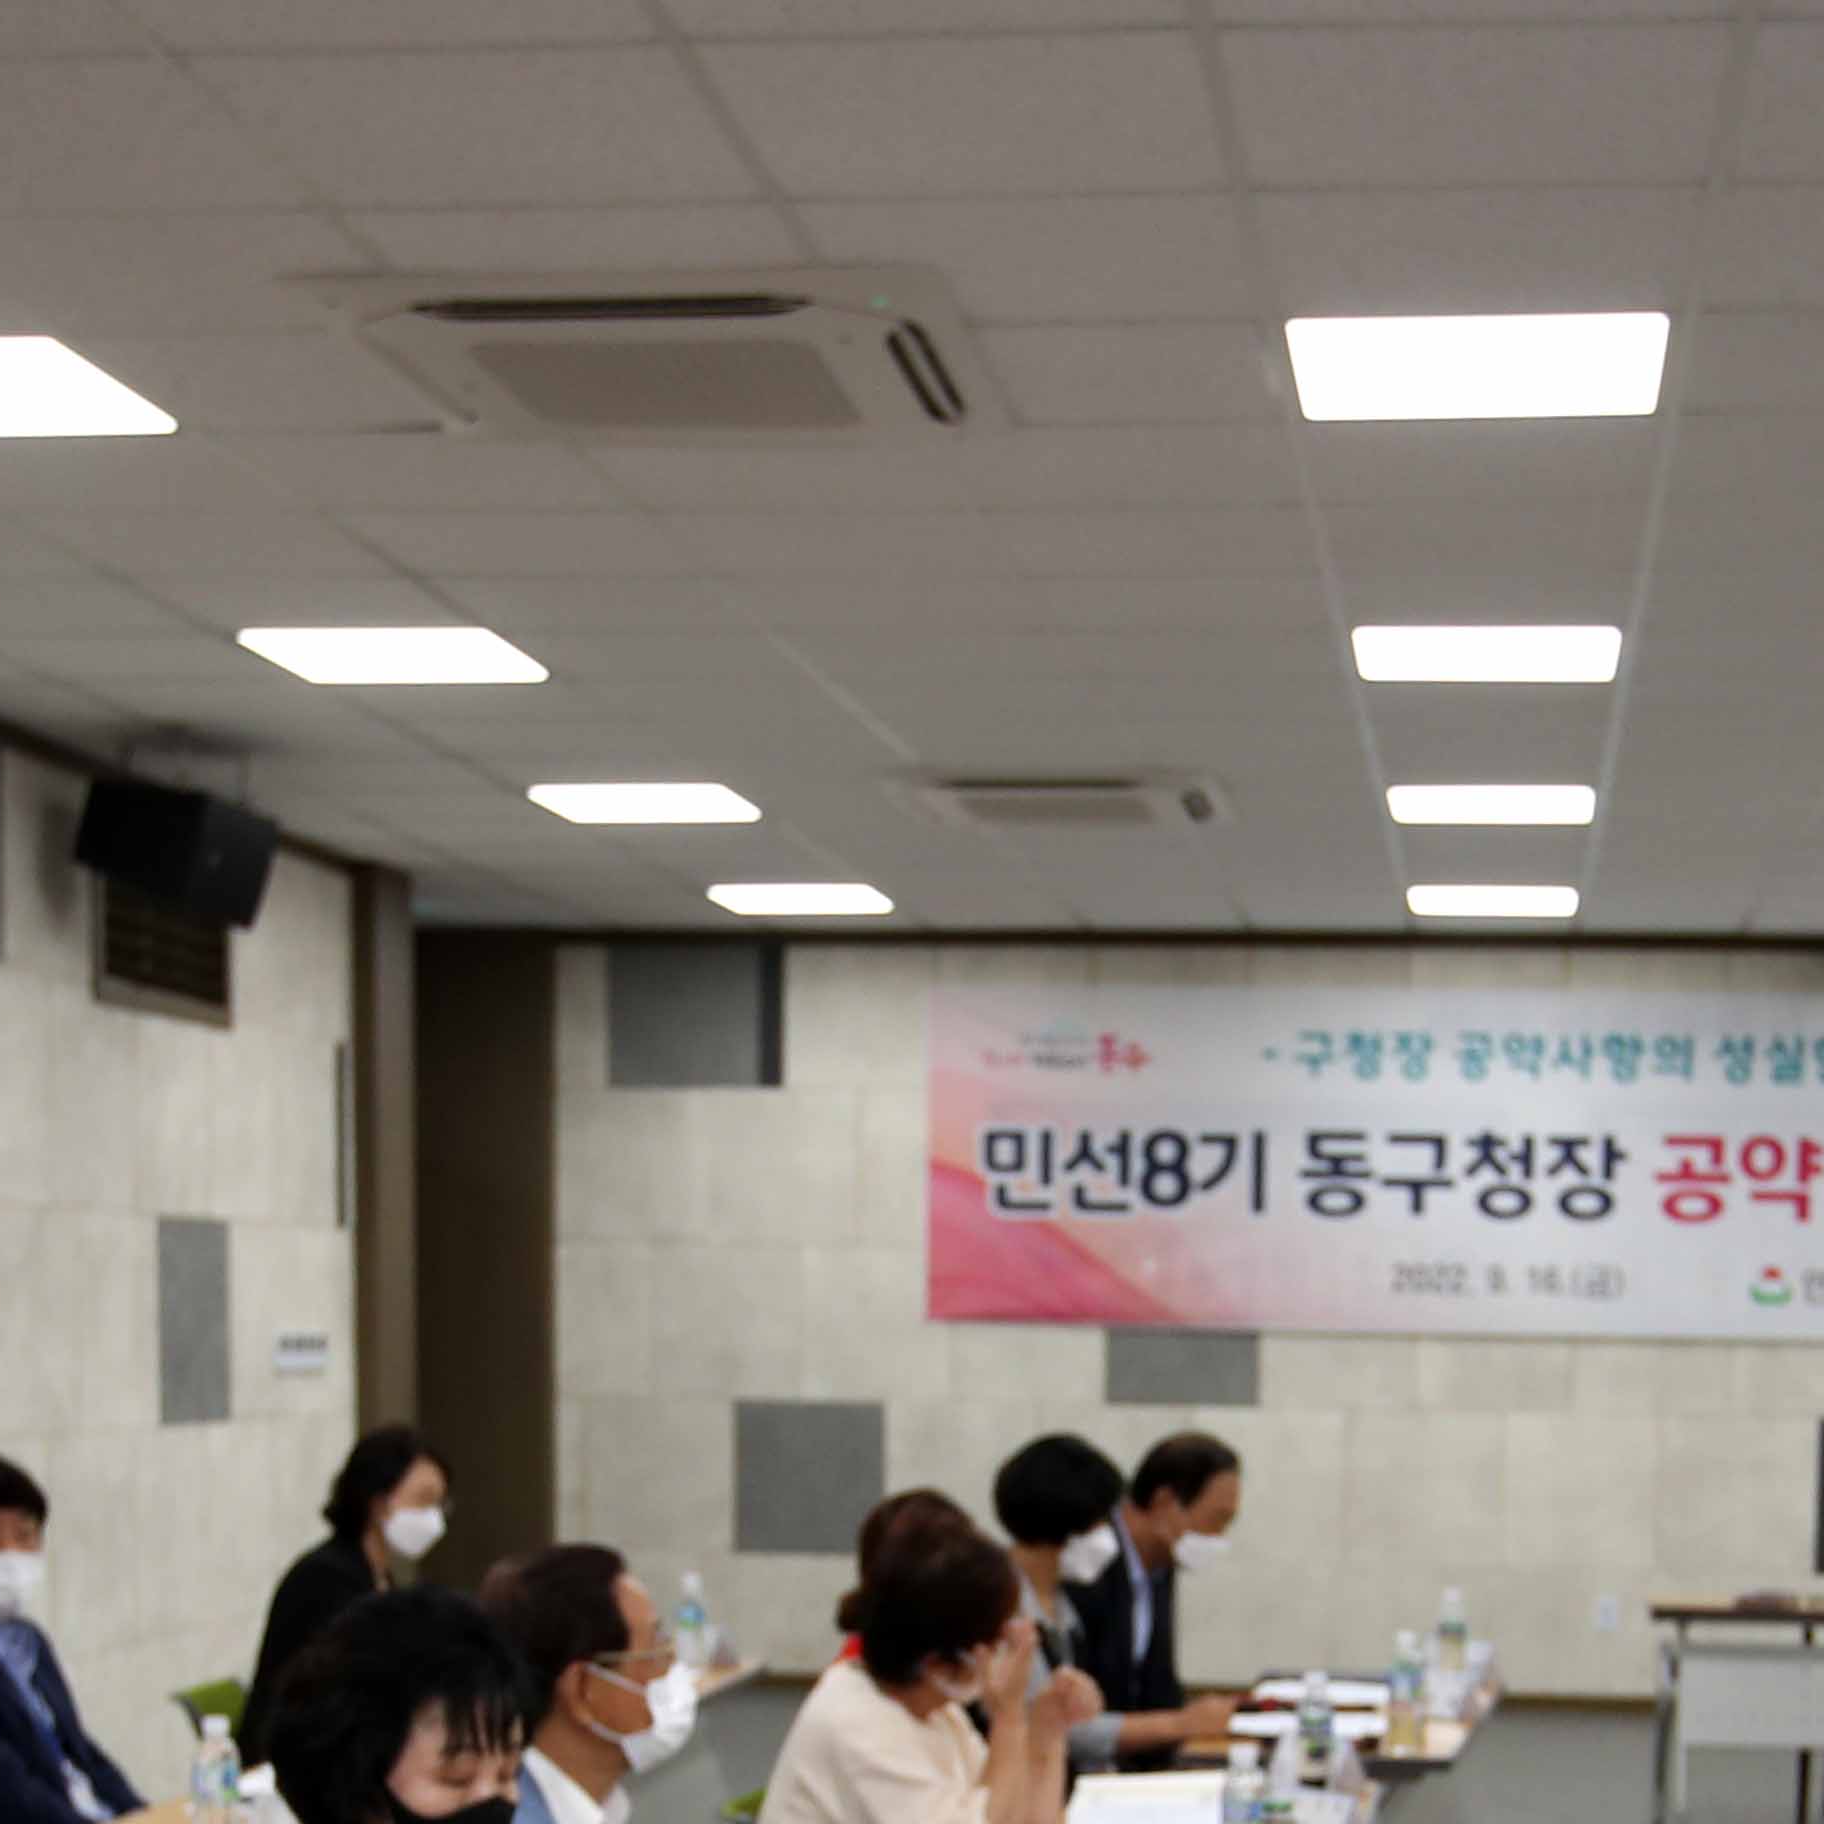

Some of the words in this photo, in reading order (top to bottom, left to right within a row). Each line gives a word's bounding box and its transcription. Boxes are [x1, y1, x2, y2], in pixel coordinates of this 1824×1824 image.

[1297, 1029, 1435, 1081] 구청장
[1457, 1030, 1694, 1084] 공약사항의
[983, 1127, 1269, 1215] 민선8기
[1298, 1130, 1627, 1220] 동구청장
[1654, 1134, 1824, 1225] 공약
